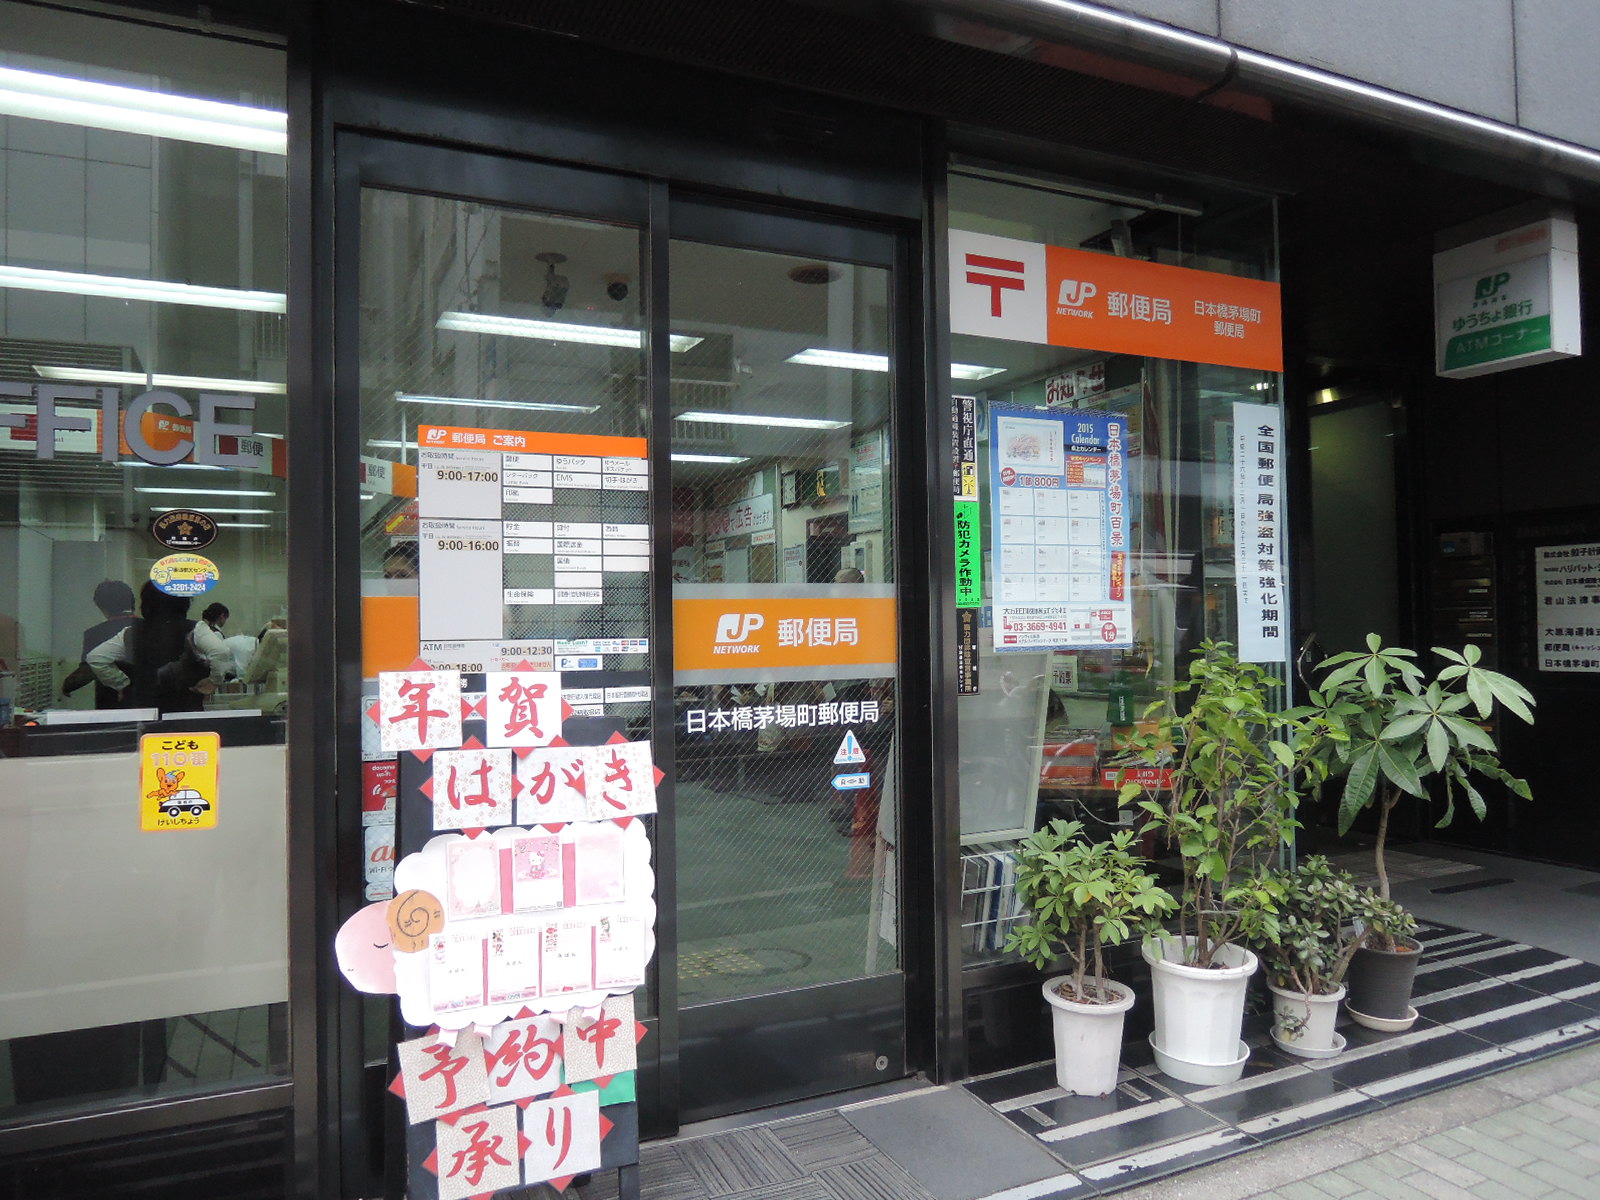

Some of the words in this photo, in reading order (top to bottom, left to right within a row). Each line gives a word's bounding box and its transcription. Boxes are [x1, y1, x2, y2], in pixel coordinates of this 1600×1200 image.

[1056, 307, 1094, 319] NETWORK
[1107, 291, 1172, 325] 郵便局
[1194, 300, 1262, 323] 日本橋茅場町
[1453, 300, 1532, 332] ゆうちょ銀行
[1214, 320, 1245, 339] 郵便局
[962, 400, 974, 462] 警視庁直通
[1078, 423, 1094, 433] 2015
[452, 432, 486, 444] 郵便局
[493, 434, 526, 447] ご案内
[1071, 433, 1101, 445] Calendar
[437, 470, 498, 482] 9:00-17:00
[556, 474, 573, 482] EMS
[1257, 424, 1279, 638] 全国郵便局強盗対策強化期間
[438, 540, 499, 551] 9:00-16:00
[957, 520, 972, 597] 防犯カメラ作動中
[778, 617, 859, 647] 郵便局
[423, 642, 443, 652] ATM
[501, 646, 552, 656] 9:00-12:30
[713, 644, 760, 654] NETWORK
[389, 677, 549, 745] 年賀
[686, 701, 879, 734] 日本橋茅場町郵便局
[162, 740, 199, 750] こども
[151, 751, 208, 767] 110番
[447, 748, 633, 811] はがき
[158, 817, 200, 826] けいしちょう
[418, 1006, 622, 1109] 予約中
[446, 1106, 573, 1186] 承り
